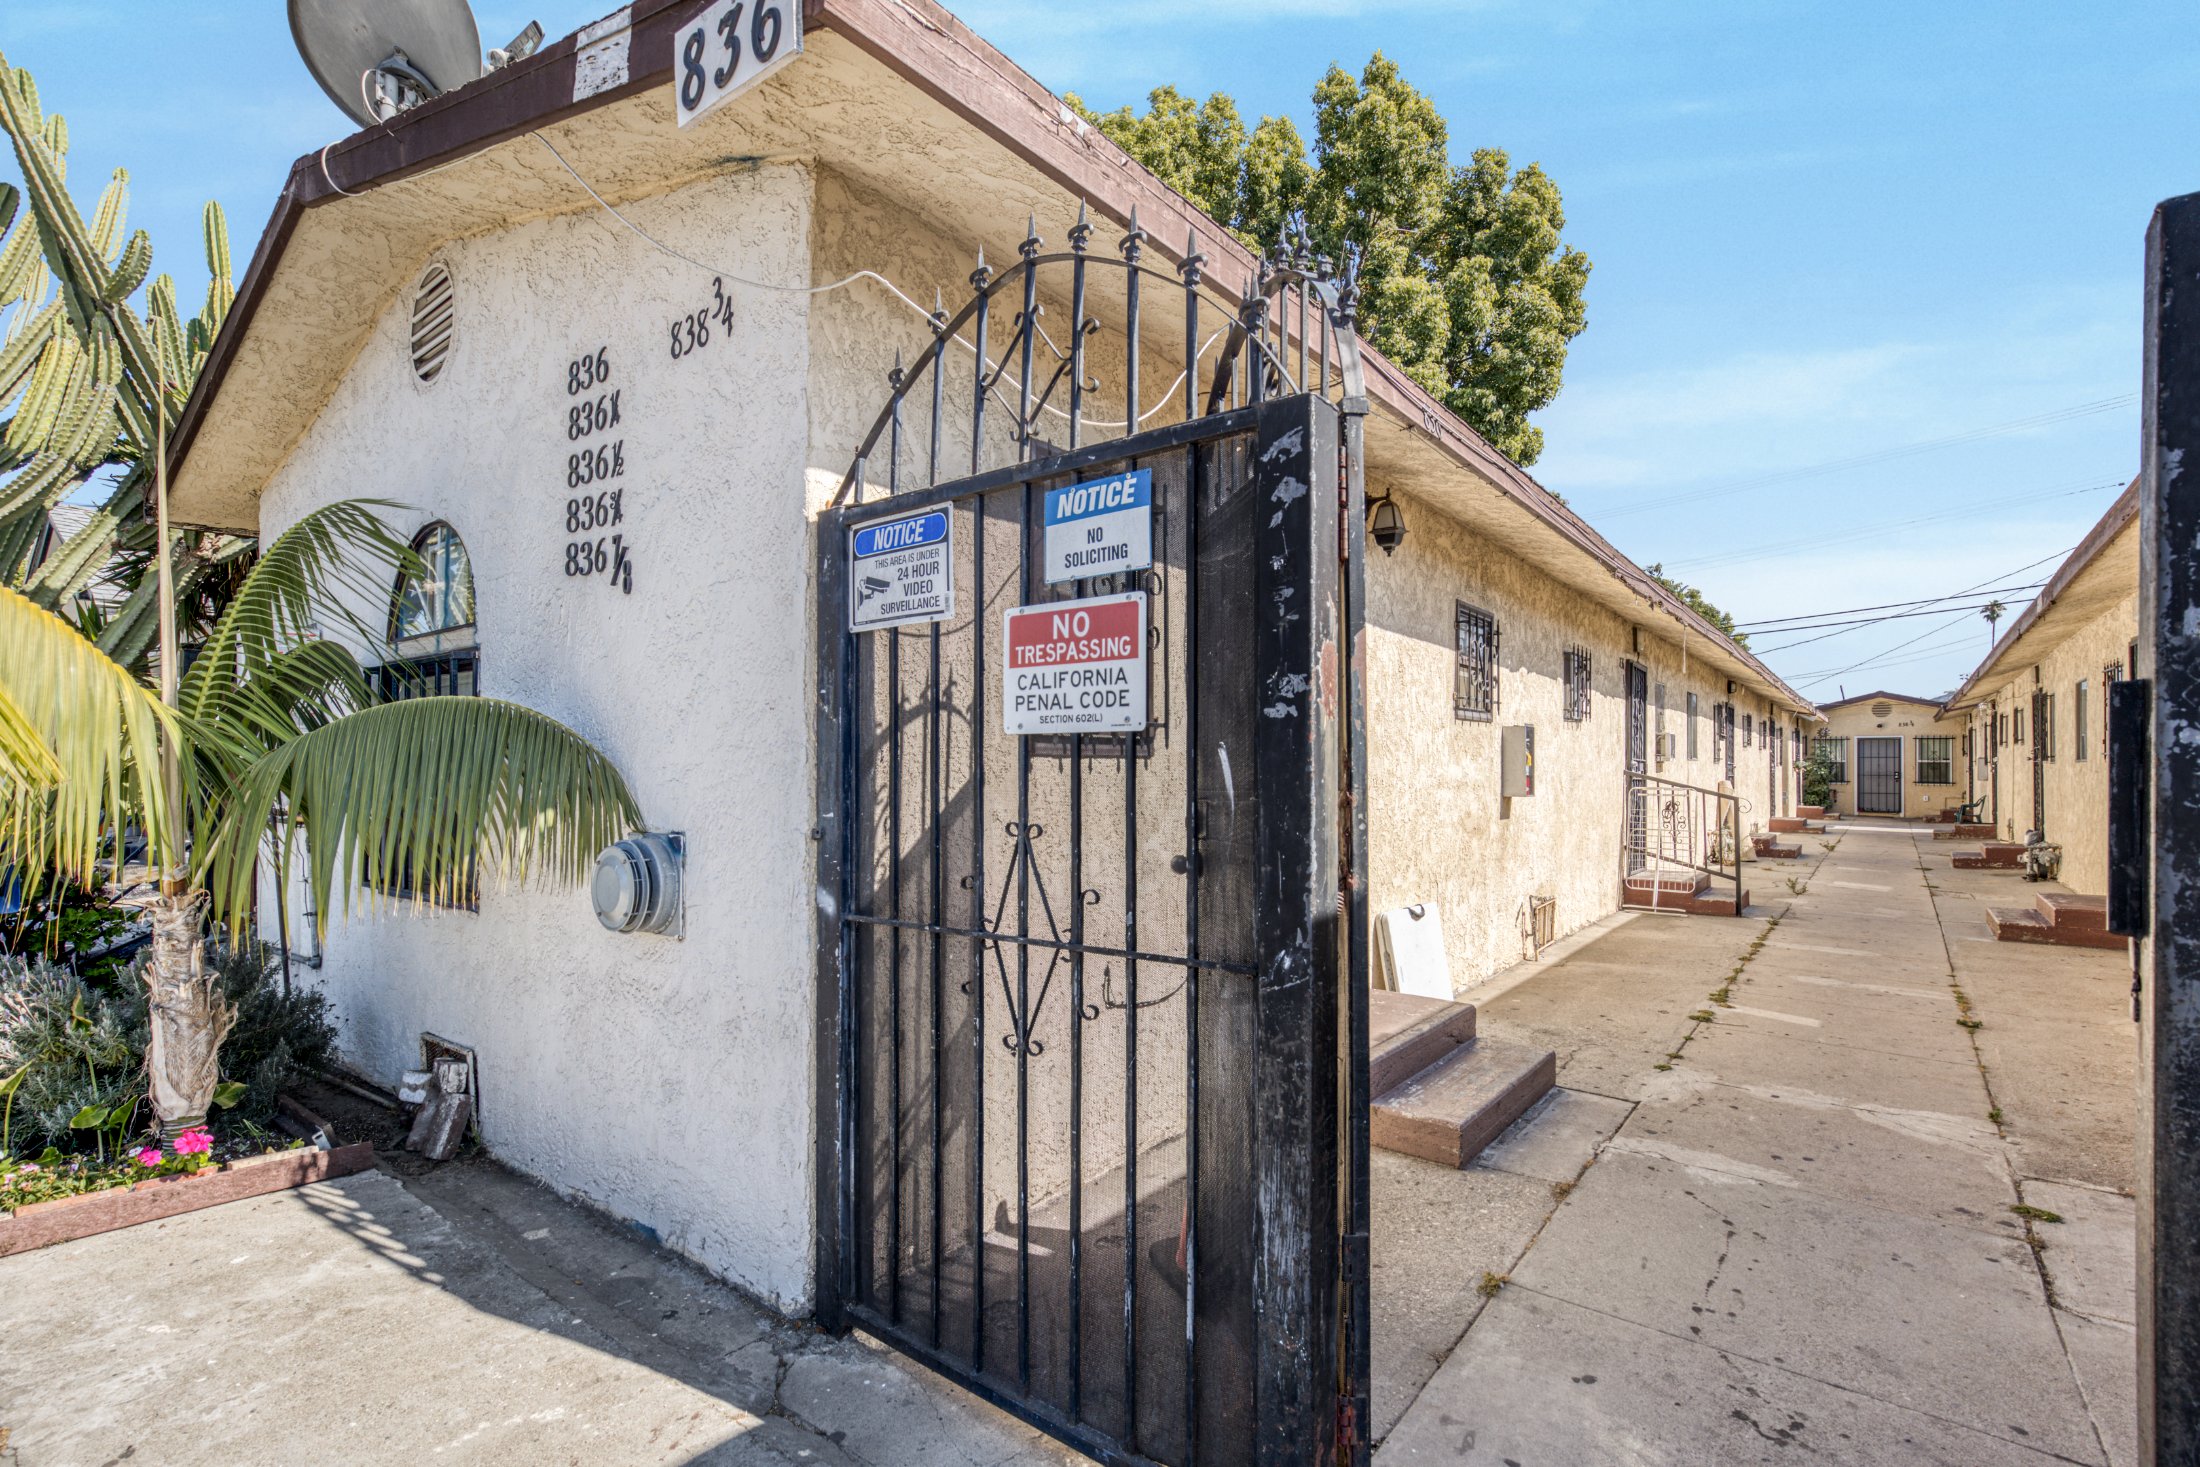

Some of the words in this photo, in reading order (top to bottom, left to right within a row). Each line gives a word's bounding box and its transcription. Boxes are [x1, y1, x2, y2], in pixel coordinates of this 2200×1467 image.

[682, 0, 782, 111] 836
[671, 307, 709, 360] 838
[567, 346, 609, 396] 836
[1057, 478, 1137, 518] NOTICE
[873, 519, 925, 551] NOTICE
[1087, 527, 1103, 544] NO
[875, 559, 889, 569] THIS
[890, 555, 906, 567] AREA
[908, 554, 915, 563] IS
[916, 548, 940, 561] UNDER
[1064, 543, 1128, 568] SOLICITING
[897, 567, 909, 580] 24
[912, 561, 940, 579] HOUR
[903, 579, 933, 597] VIDEO
[880, 595, 940, 615] SURVEILLANCE
[1053, 611, 1090, 640] NO
[1015, 636, 1131, 664] TRESPASSING
[1017, 667, 1128, 691] CALIFORNIA
[1015, 692, 1073, 712] PENAL
[1080, 689, 1130, 708] CODE
[1040, 714, 1074, 724] SECTION
[1075, 713, 1103, 723] 602(L)
